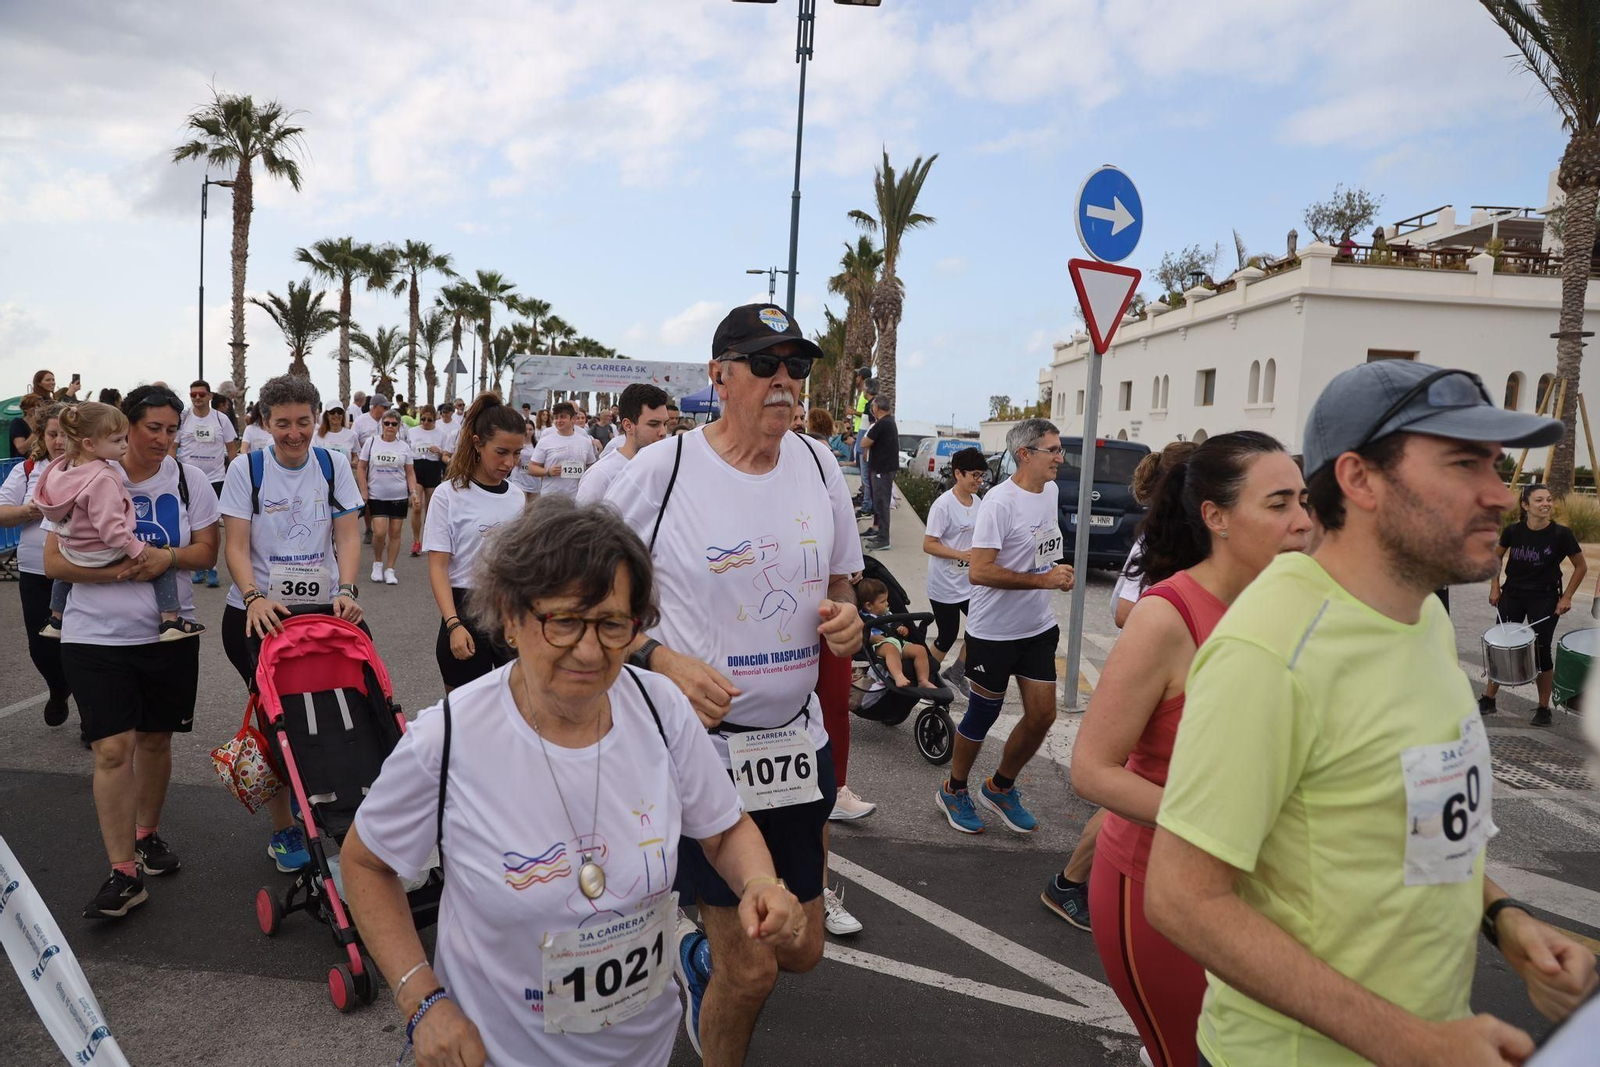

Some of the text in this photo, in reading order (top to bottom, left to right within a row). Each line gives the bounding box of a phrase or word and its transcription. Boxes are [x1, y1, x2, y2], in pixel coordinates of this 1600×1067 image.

[590, 364, 633, 372] CARRERA
[376, 454, 396, 463] 1027
[1097, 516, 1111, 525] HNR
[1038, 536, 1061, 556] 1297
[281, 580, 320, 597] 369
[727, 652, 769, 668] DONACIÓN
[770, 645, 811, 664] TRASPLANTE
[732, 667, 761, 677] Memorial
[763, 665, 783, 674] Vicente
[783, 662, 807, 672] Granados
[756, 731, 788, 741] CARRERA
[740, 752, 811, 788] 1076
[1442, 765, 1480, 842] 60
[579, 932, 595, 942] 3A
[597, 916, 645, 938] CARRERA
[562, 931, 664, 1003] 1021
